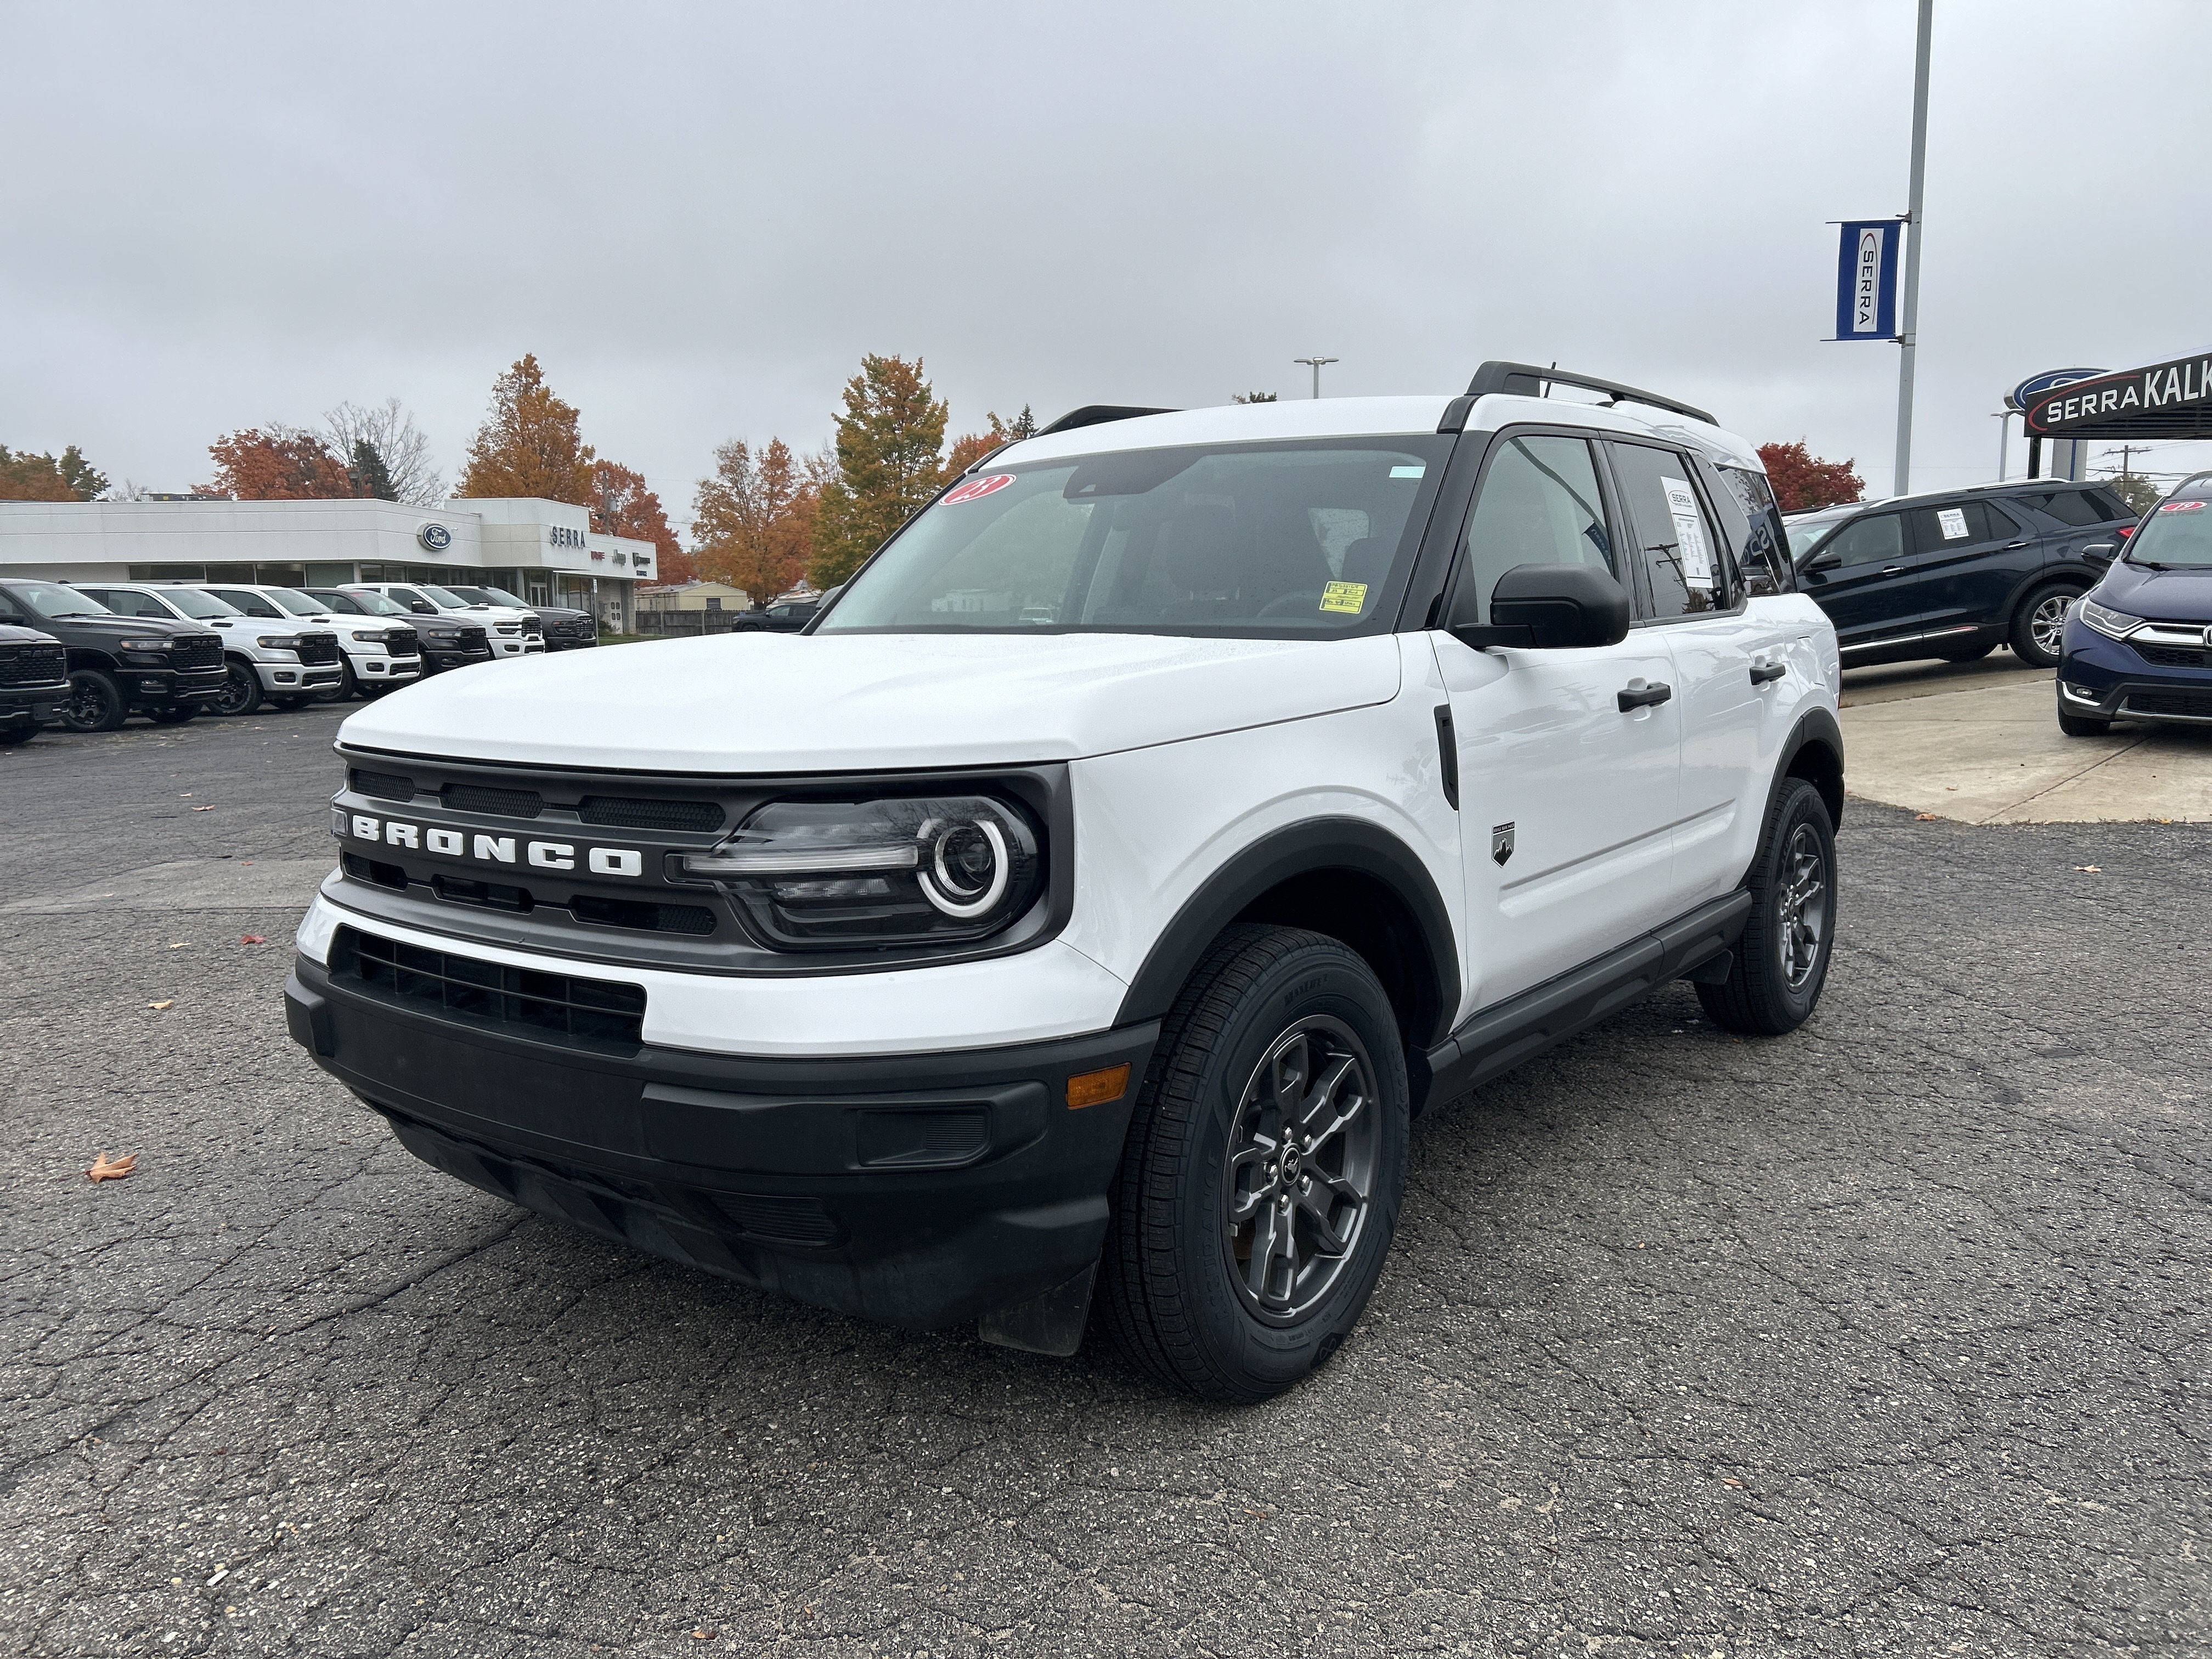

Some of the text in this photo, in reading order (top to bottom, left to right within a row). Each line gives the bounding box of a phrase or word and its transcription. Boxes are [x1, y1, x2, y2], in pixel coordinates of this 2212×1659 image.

[1859, 250, 1874, 325] SERRA
[2046, 385, 2140, 424] SERRA
[1672, 494, 1691, 504] SERRA
[430, 528, 447, 544] Ford
[551, 526, 586, 548] SERRA
[352, 815, 642, 877] BRONCO
[1201, 1149, 1229, 1320] ASSURANCE
